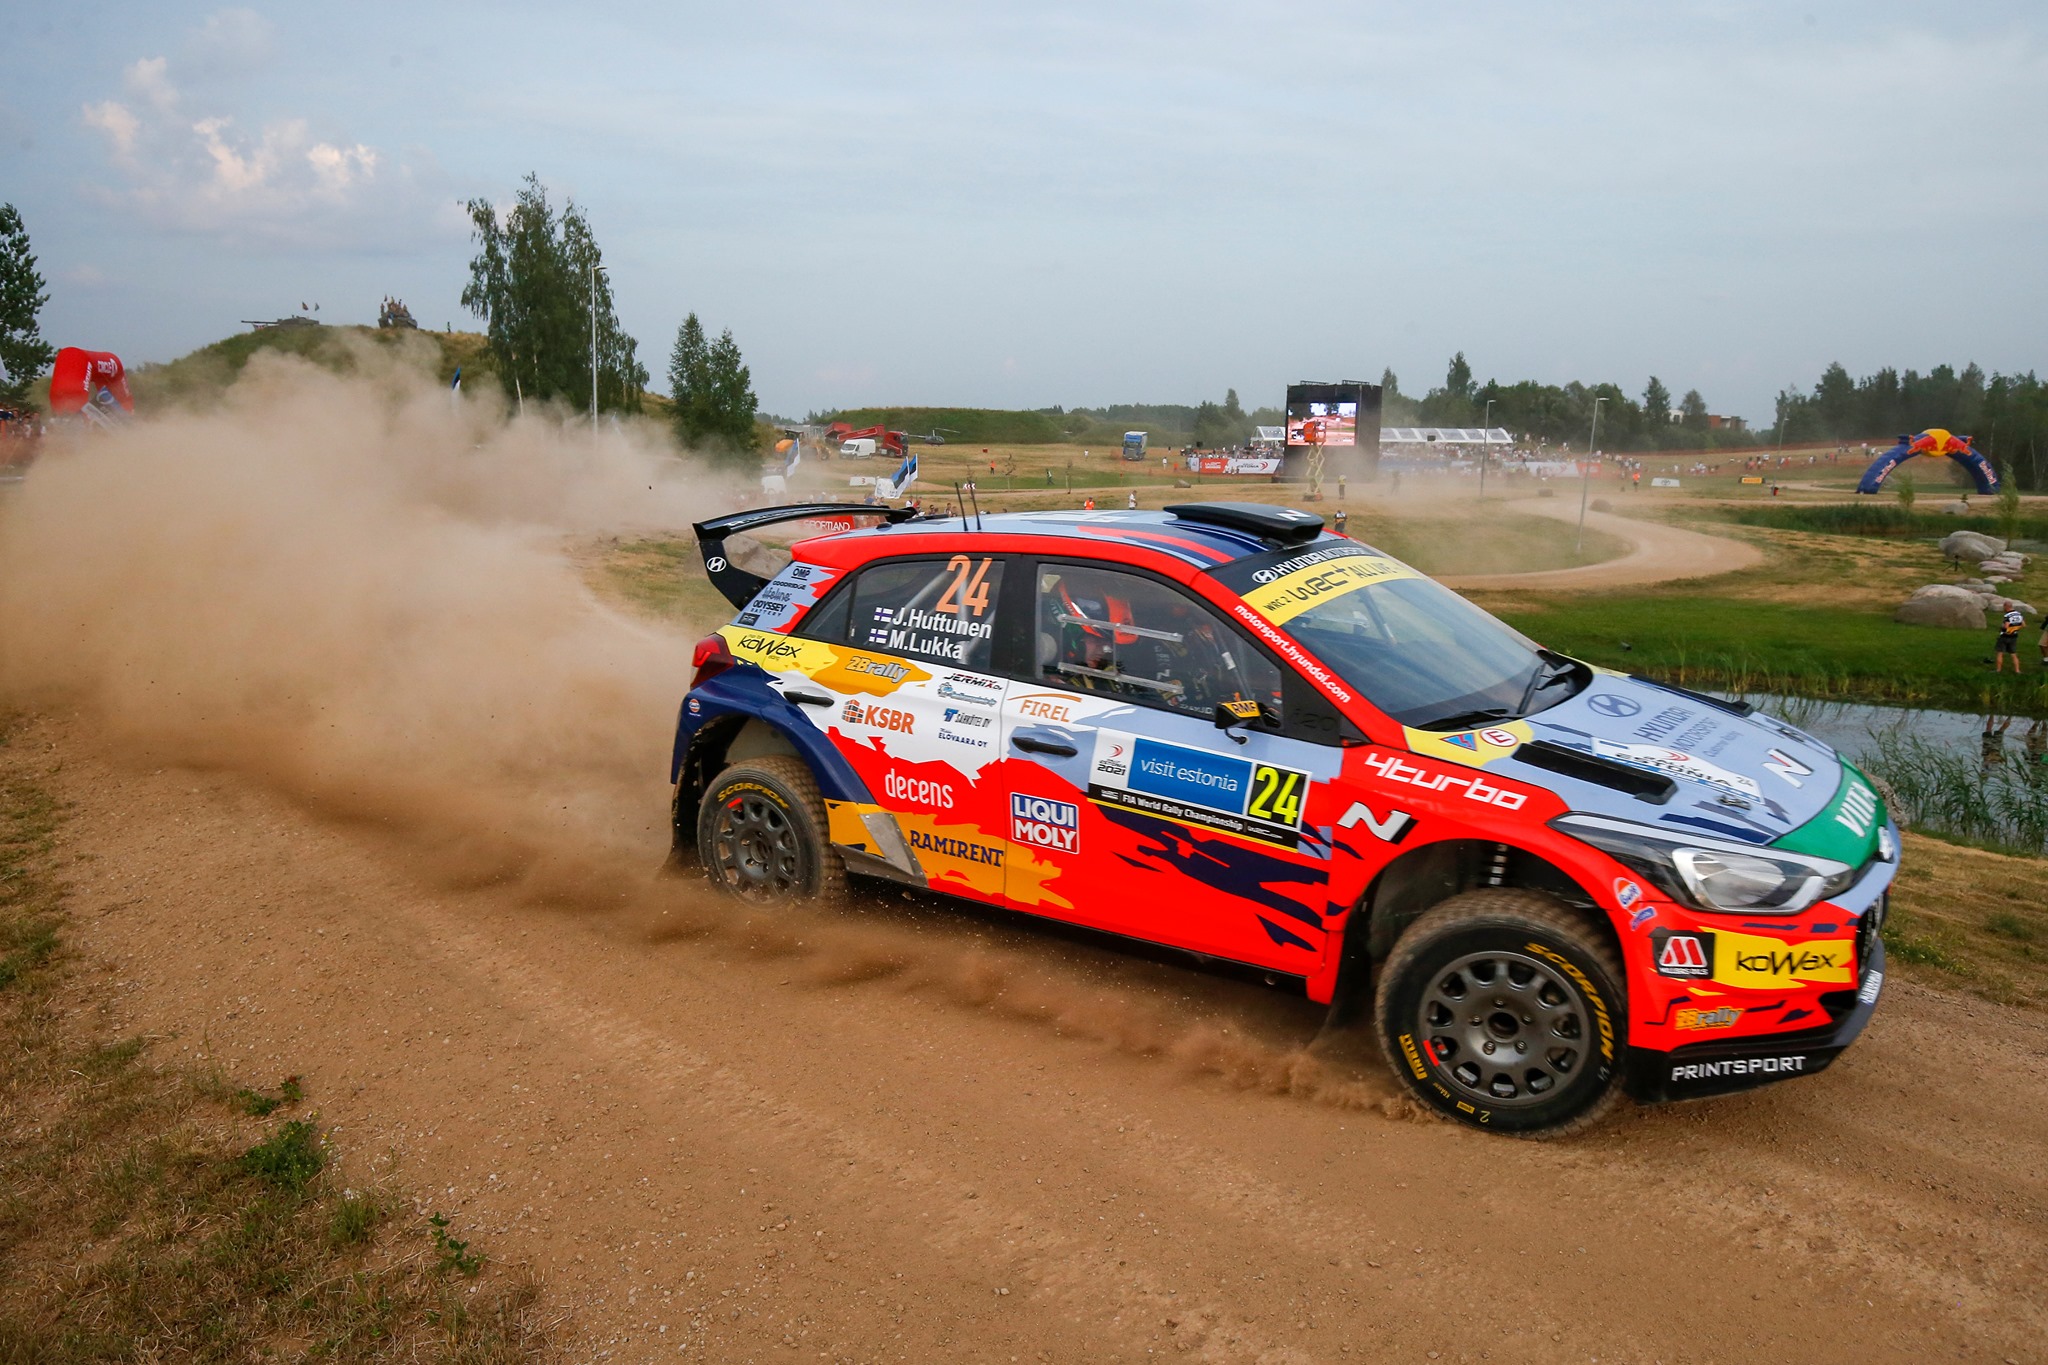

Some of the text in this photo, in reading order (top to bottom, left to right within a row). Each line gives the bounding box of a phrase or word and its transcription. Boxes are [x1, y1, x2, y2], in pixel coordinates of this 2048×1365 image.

[792, 568, 811, 578] OMP
[1271, 551, 1325, 576] HYUNDAI
[772, 580, 807, 590] GOODRIDGE
[935, 554, 993, 616] 24
[750, 608, 782, 617] BATTERY
[752, 599, 787, 613] ODYSSEY
[892, 607, 992, 639] J.Huttunen
[888, 629, 965, 660] M.Lukka
[1234, 604, 1351, 703] motorsport.hyundai.com
[845, 655, 911, 683] 2Brally
[864, 704, 915, 735] KSBR
[1019, 699, 1071, 723] FIREL
[1632, 706, 1696, 742] HYUNDAI
[938, 732, 988, 748] ELOVAARA OY
[1668, 716, 1722, 753] MOTORSPORT
[1097, 764, 1127, 776] 2021
[1140, 758, 1239, 792] visit estonia
[1364, 753, 1529, 811] 4turbo
[1615, 752, 1732, 787] ESTONIA
[1762, 748, 1814, 790] N
[717, 782, 790, 809] SCORPION
[885, 768, 954, 809] decens
[1249, 766, 1300, 825] 24
[1014, 796, 1075, 828] LIQUI
[1122, 794, 1138, 805] FIA
[1137, 797, 1162, 811] World
[1162, 802, 1184, 817] Rally
[1184, 808, 1243, 831] Championship
[1336, 801, 1413, 842] N
[910, 830, 1004, 867] RAMIRENT
[1015, 820, 1077, 851] MOLY
[1523, 942, 1616, 1063] SCORPION
[1398, 1033, 1429, 1080] PIRELLI
[1671, 1055, 1807, 1082] PRINTSPORT
